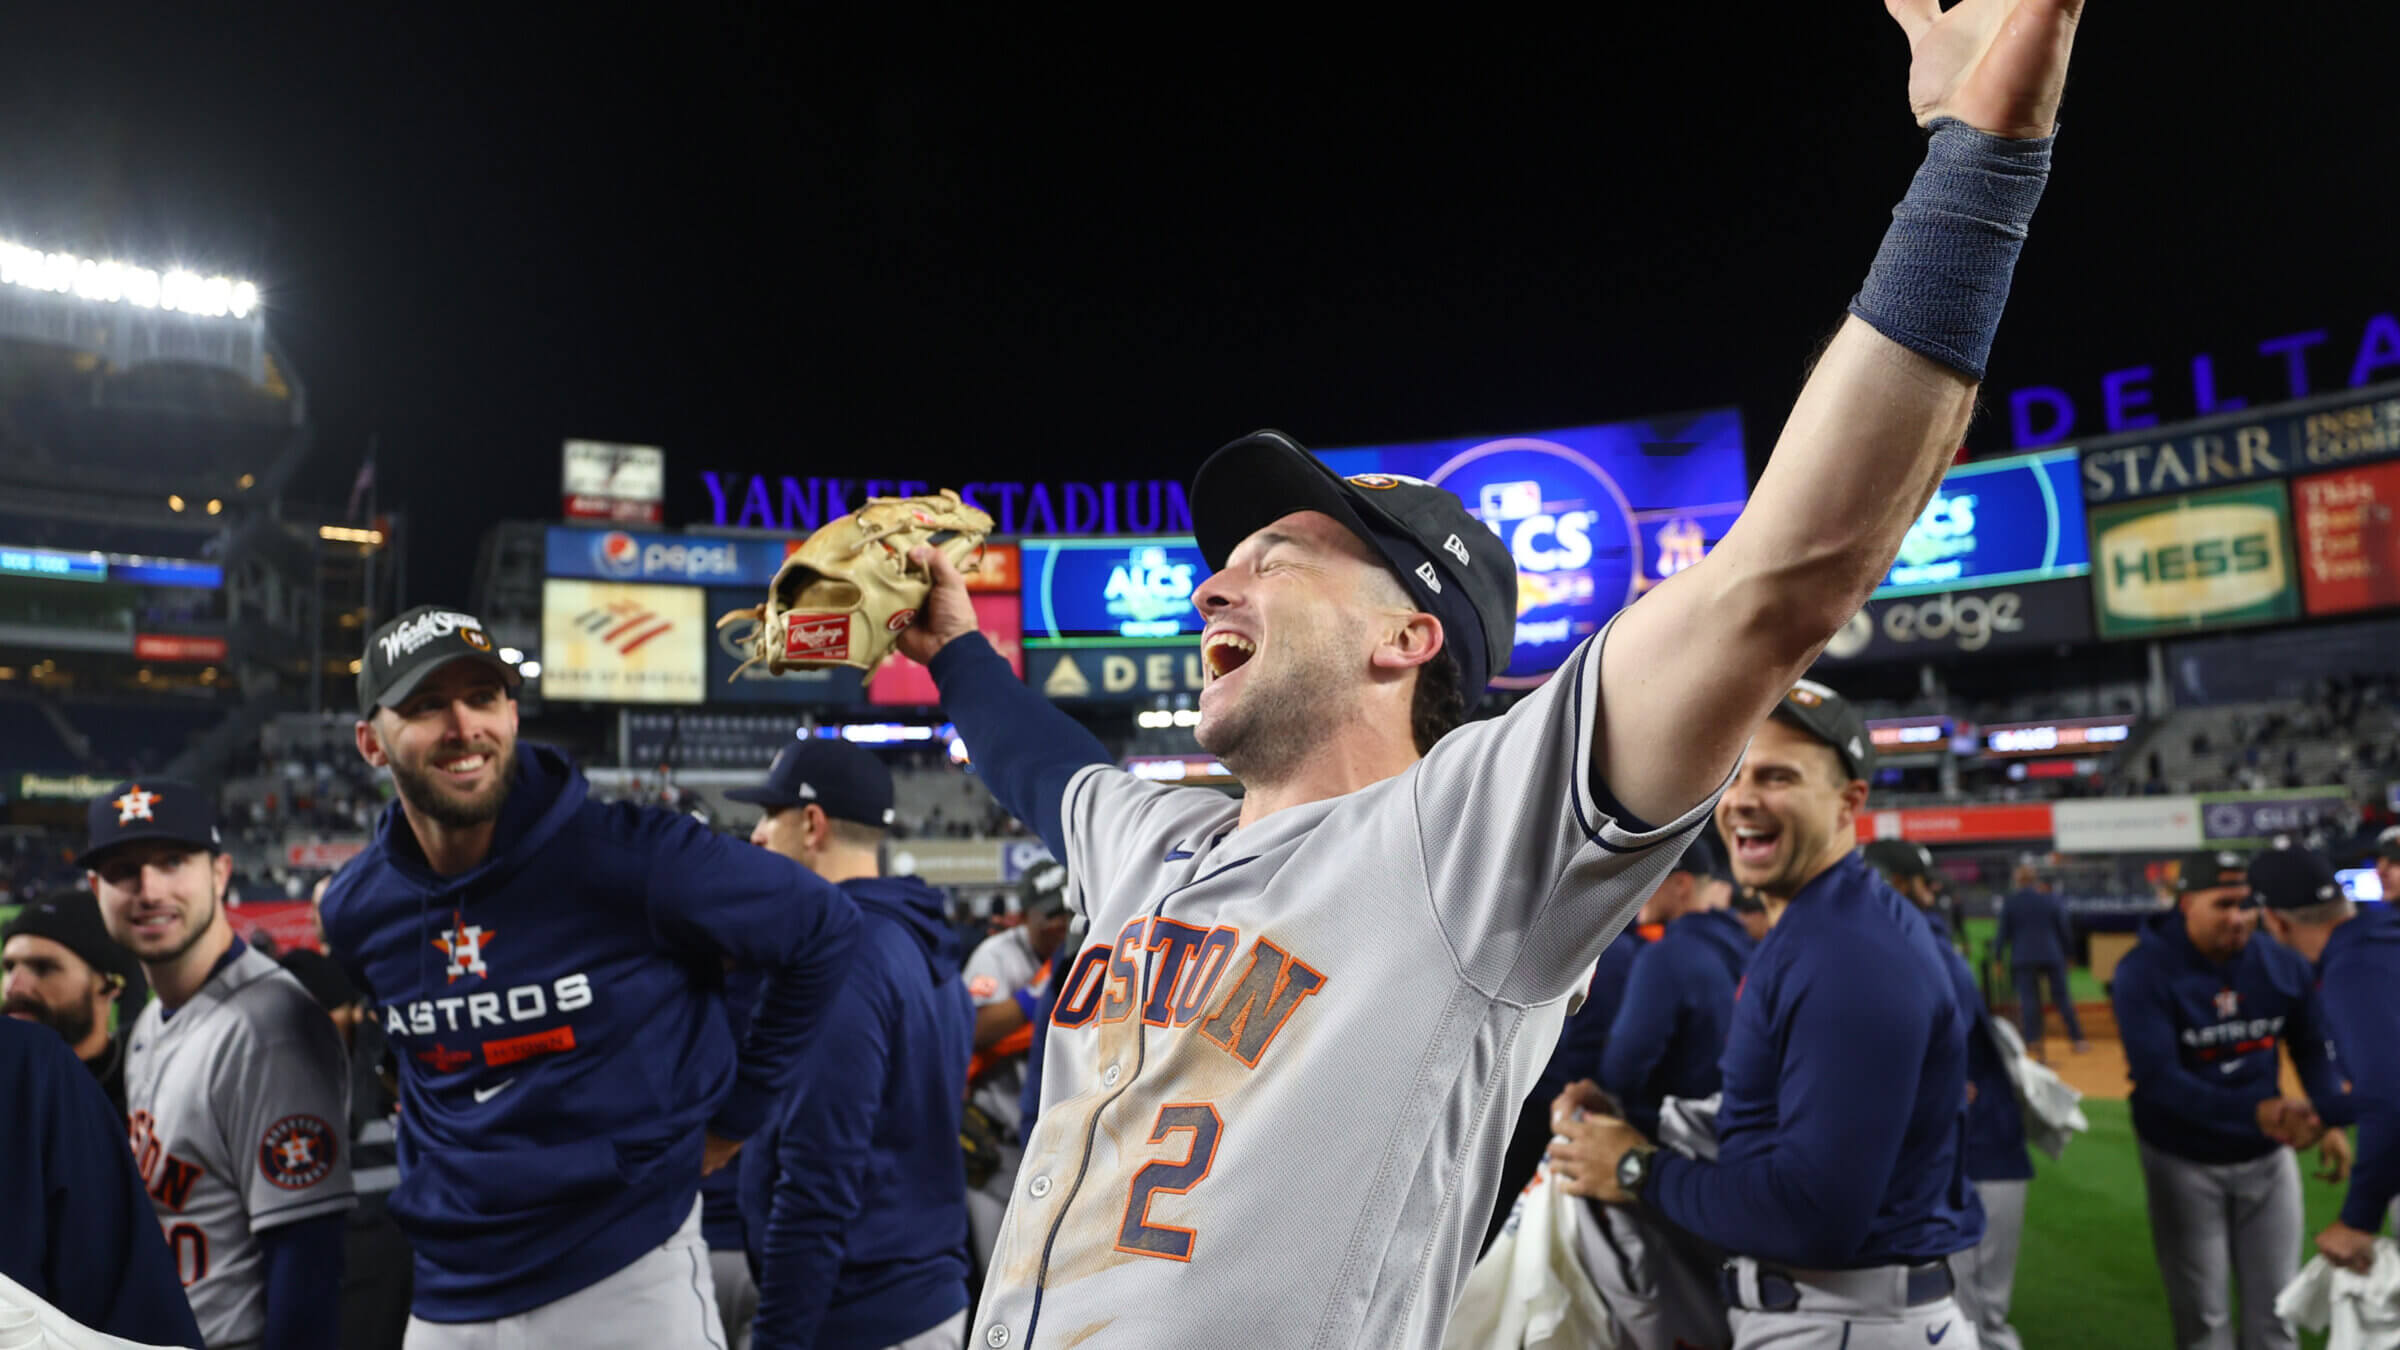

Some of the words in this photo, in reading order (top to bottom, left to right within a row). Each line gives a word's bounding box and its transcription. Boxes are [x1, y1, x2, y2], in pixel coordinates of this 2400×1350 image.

[2009, 312, 2400, 449] DELTA
[2083, 426, 2285, 500] STARR
[643, 543, 738, 580] pepsi
[1103, 564, 1196, 601] ALCS
[2114, 533, 2271, 588] HESS
[379, 609, 437, 666] World
[790, 624, 844, 648] Rawlings
[1883, 591, 2025, 651] edge
[386, 972, 594, 1036] ASTROS
[1114, 1102, 1224, 1263] 2
